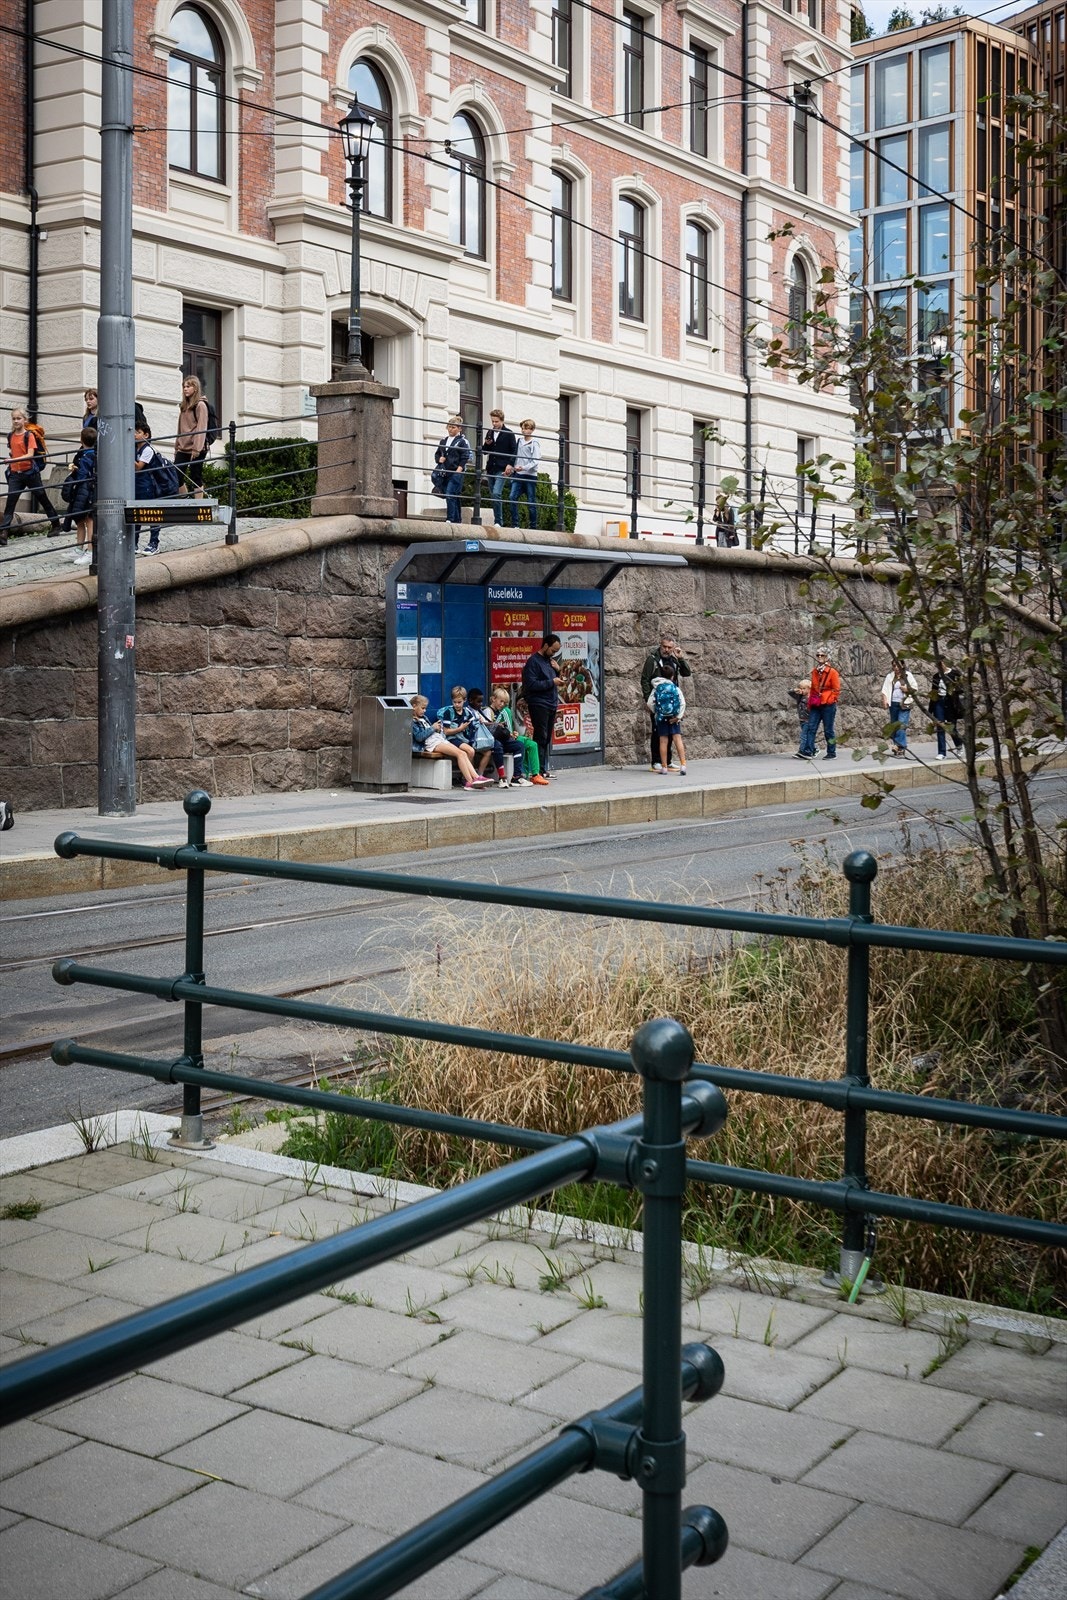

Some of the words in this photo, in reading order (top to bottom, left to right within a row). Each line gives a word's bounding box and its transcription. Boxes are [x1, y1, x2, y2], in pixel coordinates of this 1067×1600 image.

[488, 587, 523, 599] Ruseløkka
[511, 613, 530, 621] EXTRA
[570, 614, 587, 622] EXTRA
[563, 641, 587, 649] ITALIENSKE
[570, 648, 581, 657] UKER
[565, 716, 574, 730] 60
